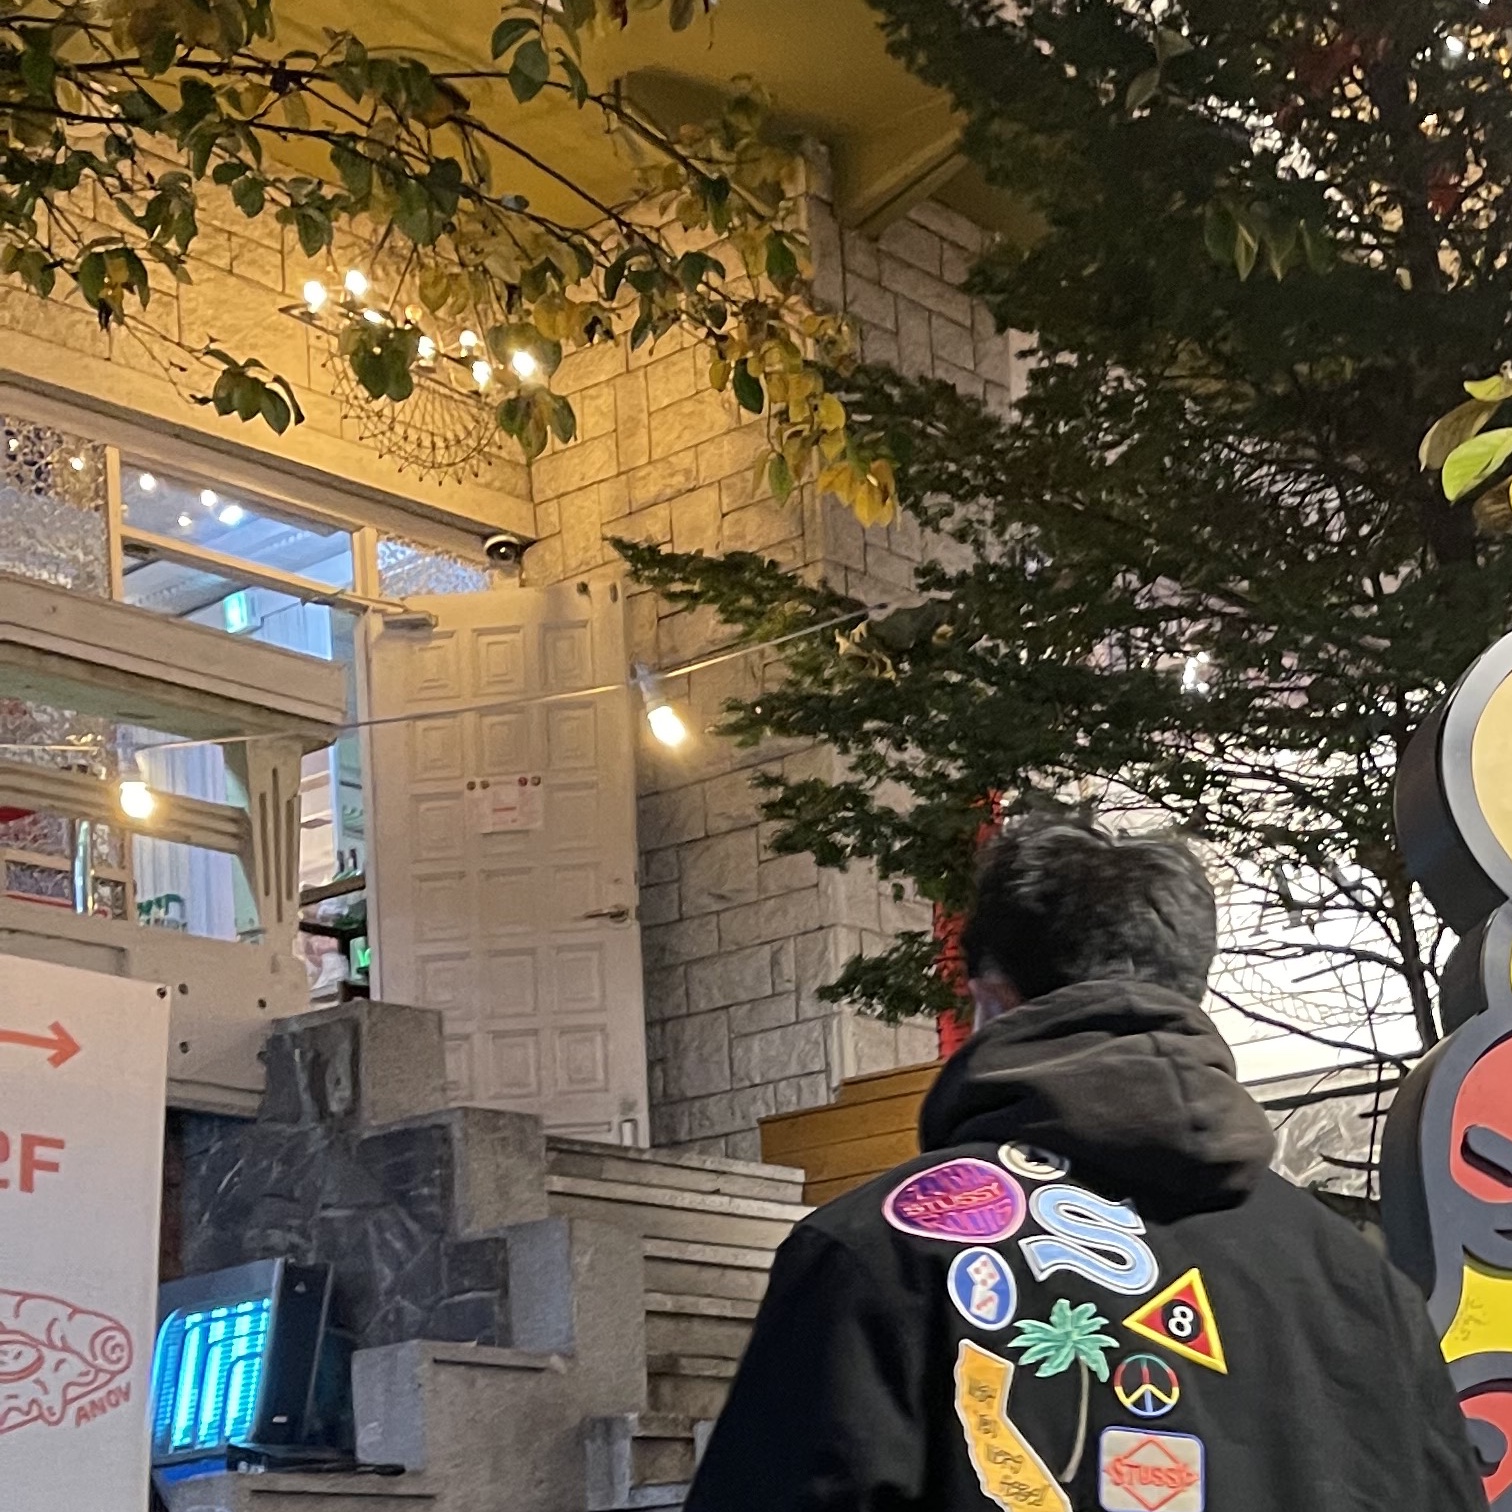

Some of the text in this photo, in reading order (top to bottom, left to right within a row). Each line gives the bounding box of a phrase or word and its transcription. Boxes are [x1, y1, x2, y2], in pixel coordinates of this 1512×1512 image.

[1018, 1184, 1159, 1295] S
[1168, 1305, 1194, 1337] 8
[74, 1381, 131, 1429] ANOV
